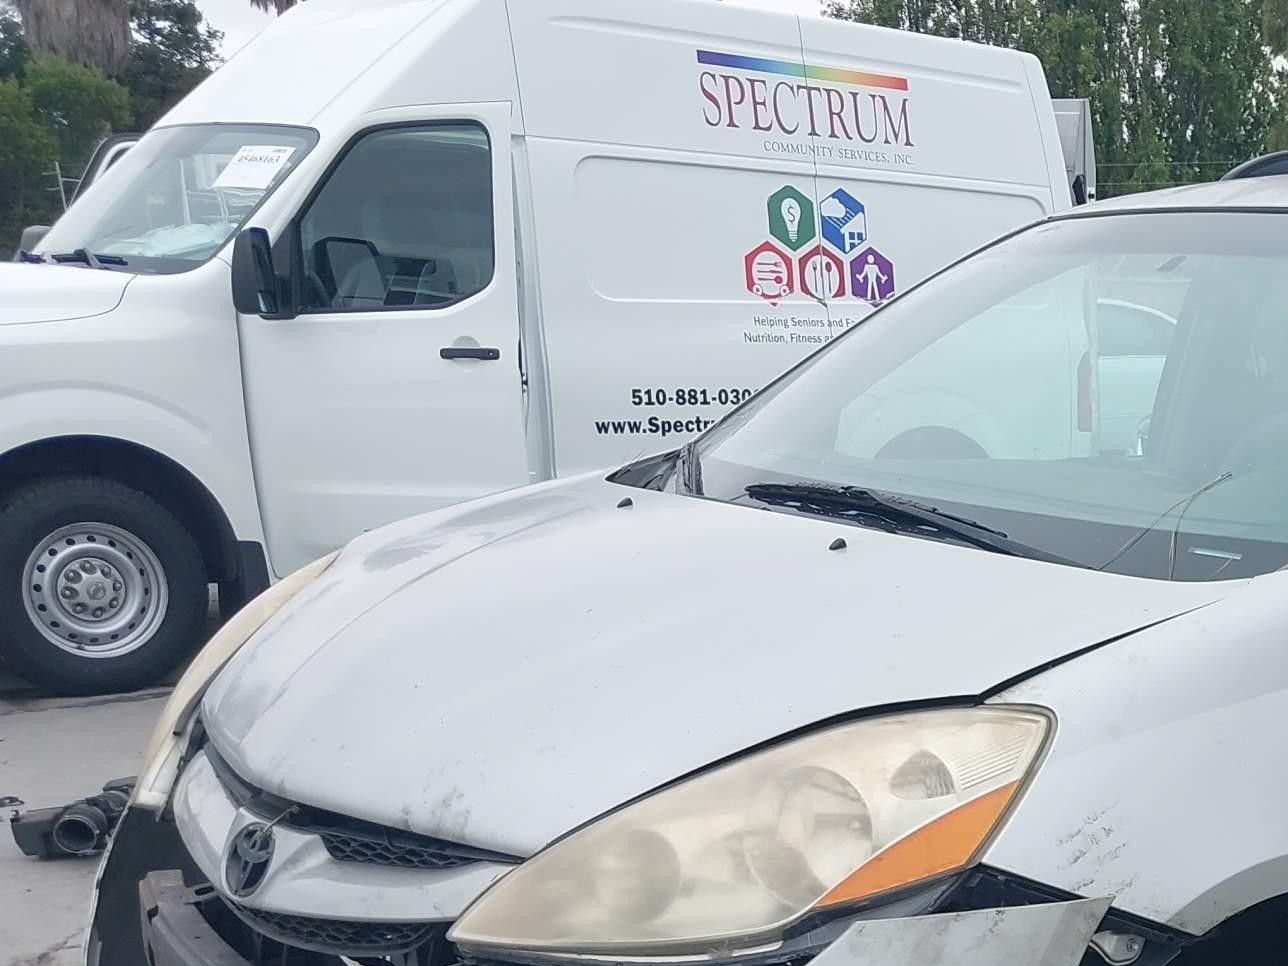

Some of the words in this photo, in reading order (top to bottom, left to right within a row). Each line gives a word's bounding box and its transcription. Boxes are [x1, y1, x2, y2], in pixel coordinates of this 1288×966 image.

[699, 71, 915, 147] SPECTRUM
[763, 140, 834, 158] COMMUNITY
[838, 148, 890, 164] SERVICES,
[893, 153, 916, 165] INC.
[753, 316, 790, 328] Helping
[791, 317, 825, 328] Seniors
[827, 318, 844, 328] and
[743, 332, 788, 344] Nutrition,
[790, 333, 823, 344] Fitness
[631, 388, 760, 406] 510-881-030
[595, 415, 716, 437] www.Spectr
